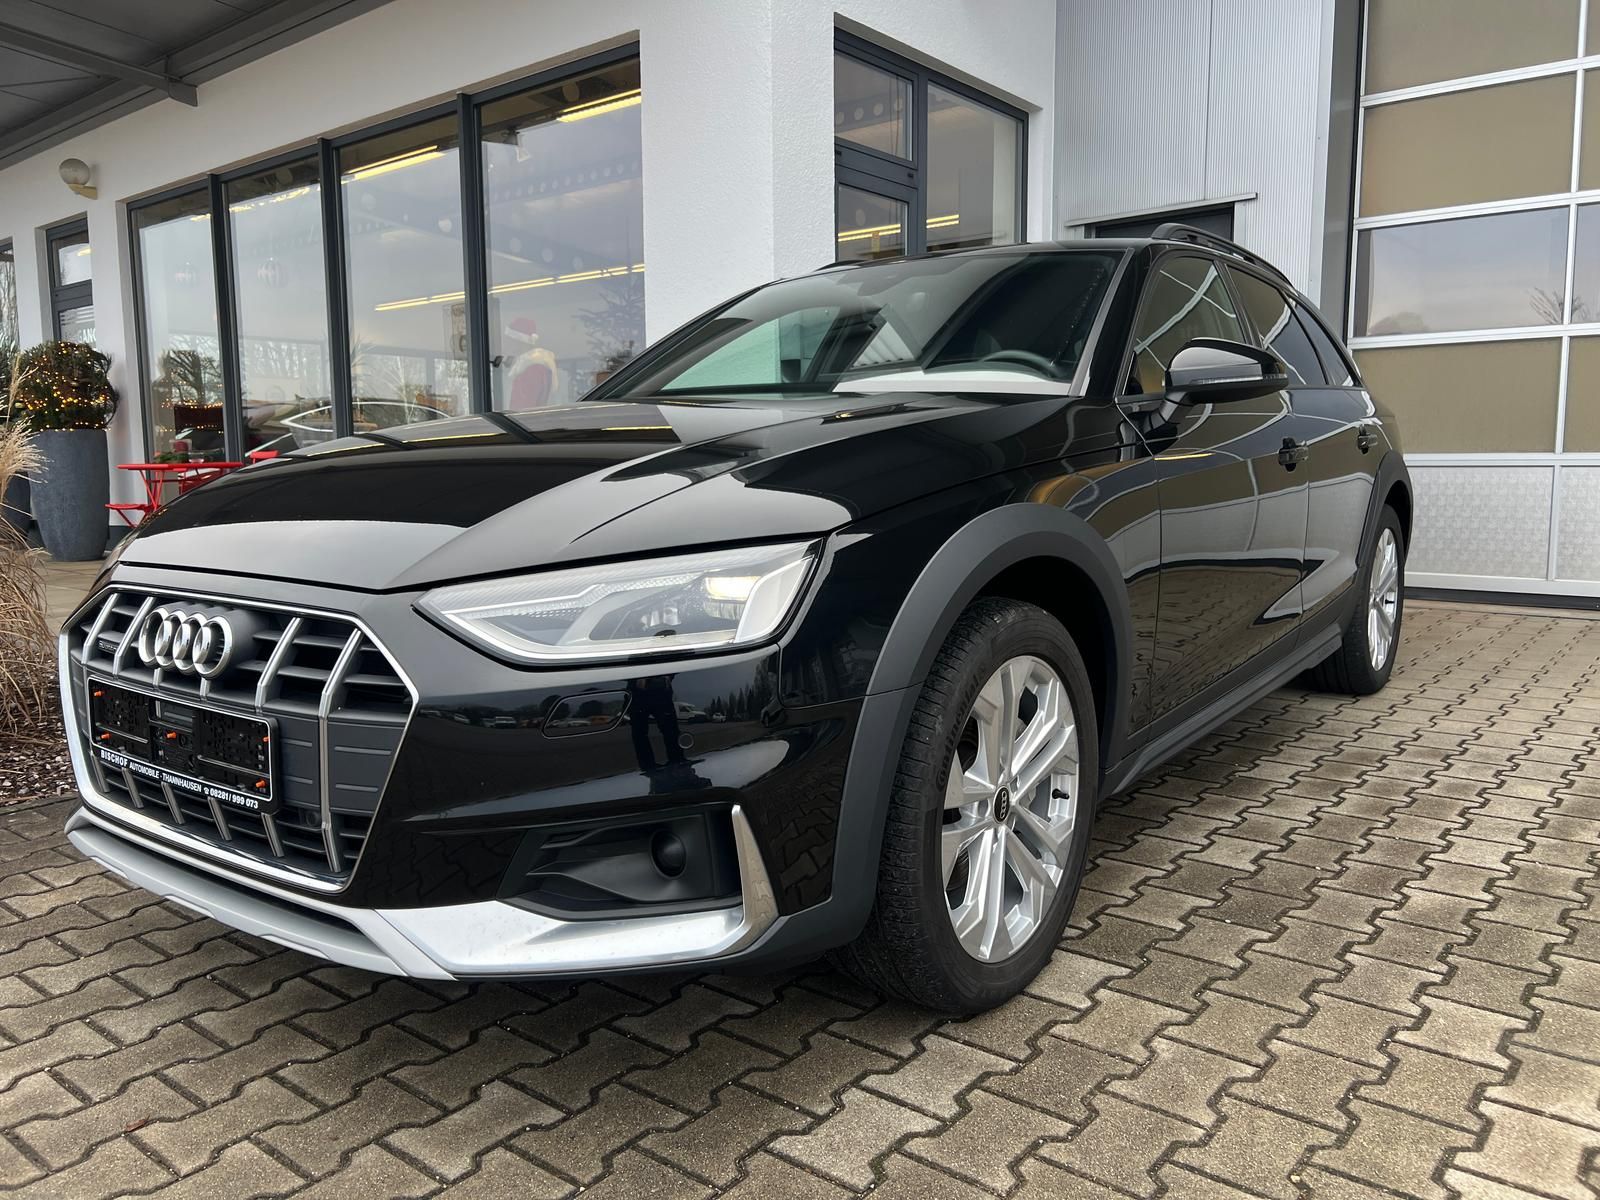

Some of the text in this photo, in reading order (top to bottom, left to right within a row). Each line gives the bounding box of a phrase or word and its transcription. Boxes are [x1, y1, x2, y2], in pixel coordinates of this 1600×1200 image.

[100, 749, 128, 767] BISCHOF
[129, 761, 160, 779] AUTOMOBILE
[162, 773, 202, 793] THANNHAUSEN
[232, 794, 245, 806] 999
[246, 798, 258, 809] 073
